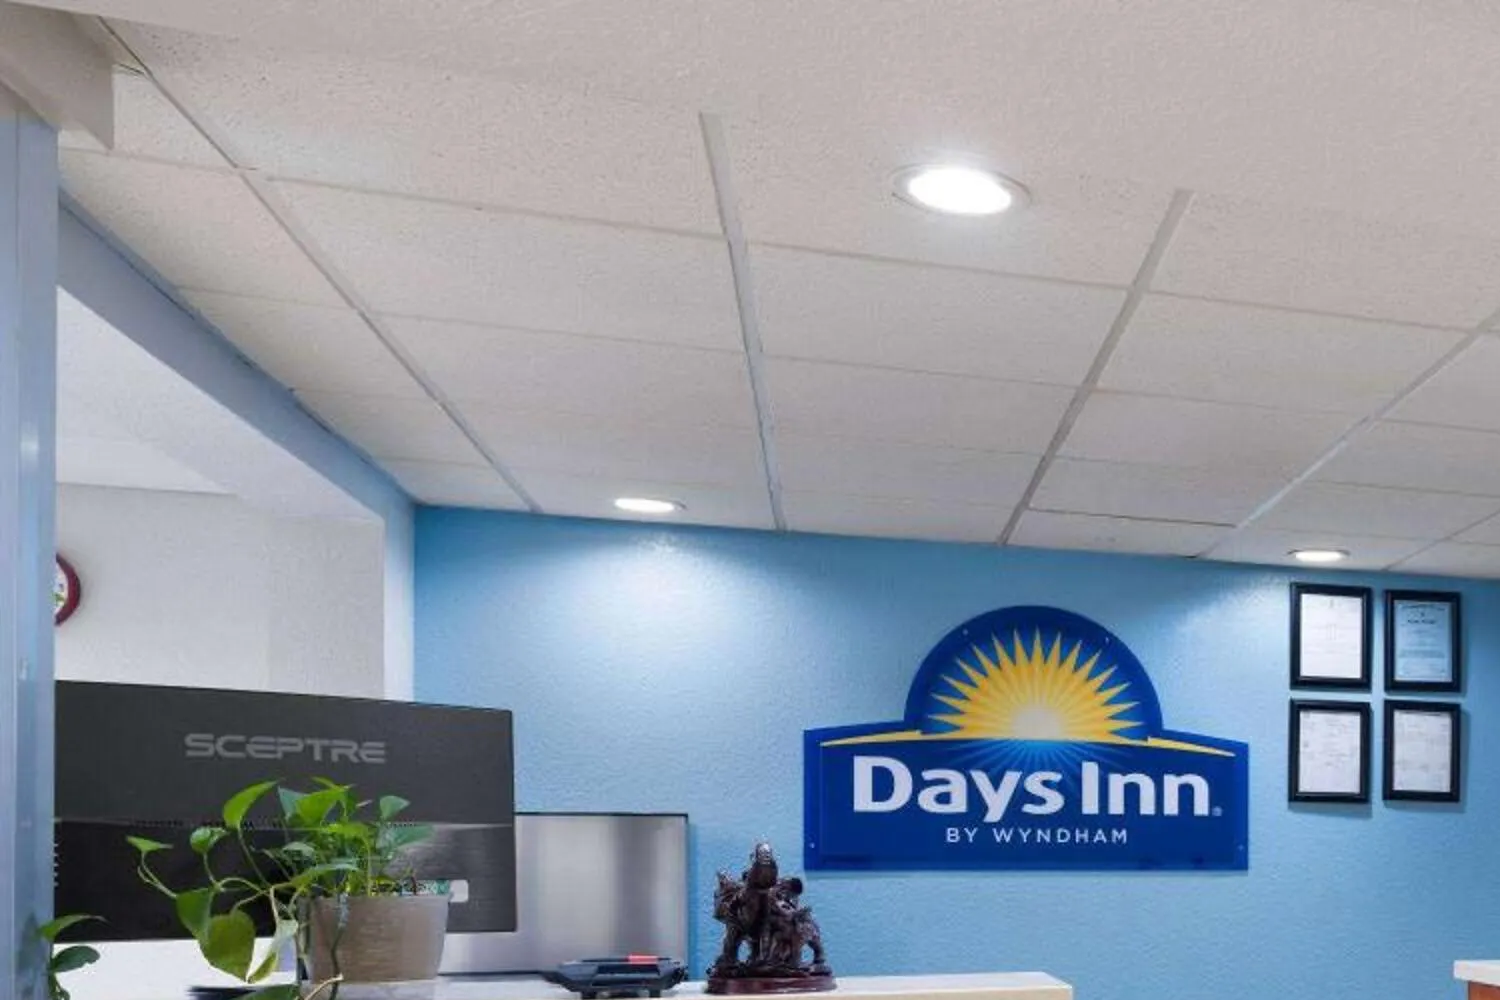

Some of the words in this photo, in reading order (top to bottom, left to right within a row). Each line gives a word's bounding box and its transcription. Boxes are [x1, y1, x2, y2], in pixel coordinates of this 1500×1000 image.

[184, 733, 386, 764] SCEPTRE
[853, 755, 1065, 823] Days
[1081, 760, 1210, 817] Inn
[946, 827, 978, 843] BY
[993, 828, 1128, 844] WYNDHAM
